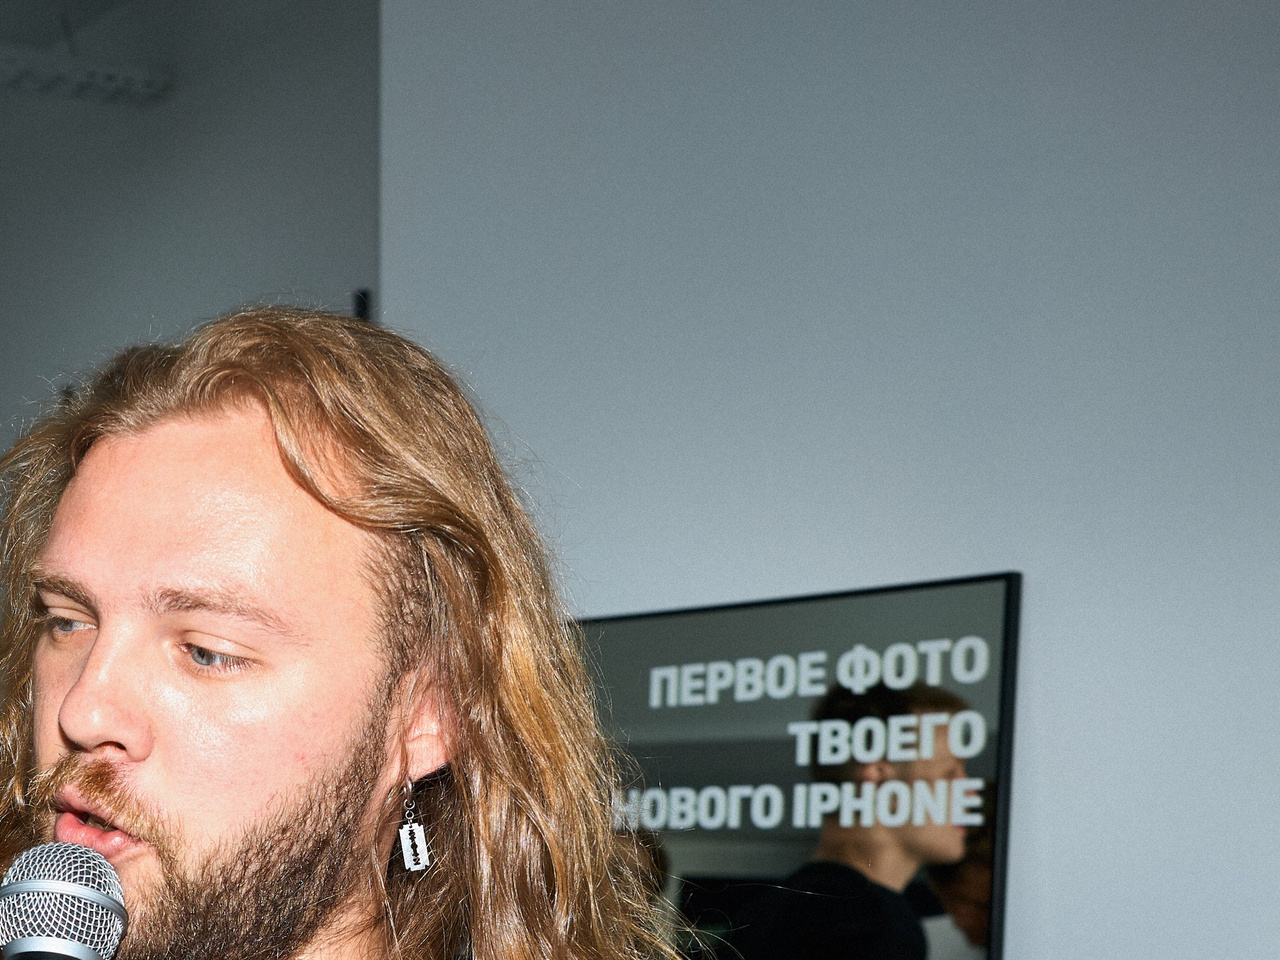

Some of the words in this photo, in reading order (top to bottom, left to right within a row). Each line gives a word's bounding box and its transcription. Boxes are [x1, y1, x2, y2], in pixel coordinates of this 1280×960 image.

[649, 651, 827, 708] ПЕРВОЕ
[835, 636, 989, 695] ФОТО
[788, 711, 987, 766] ТВОЕГО
[792, 778, 985, 829] IPHONE
